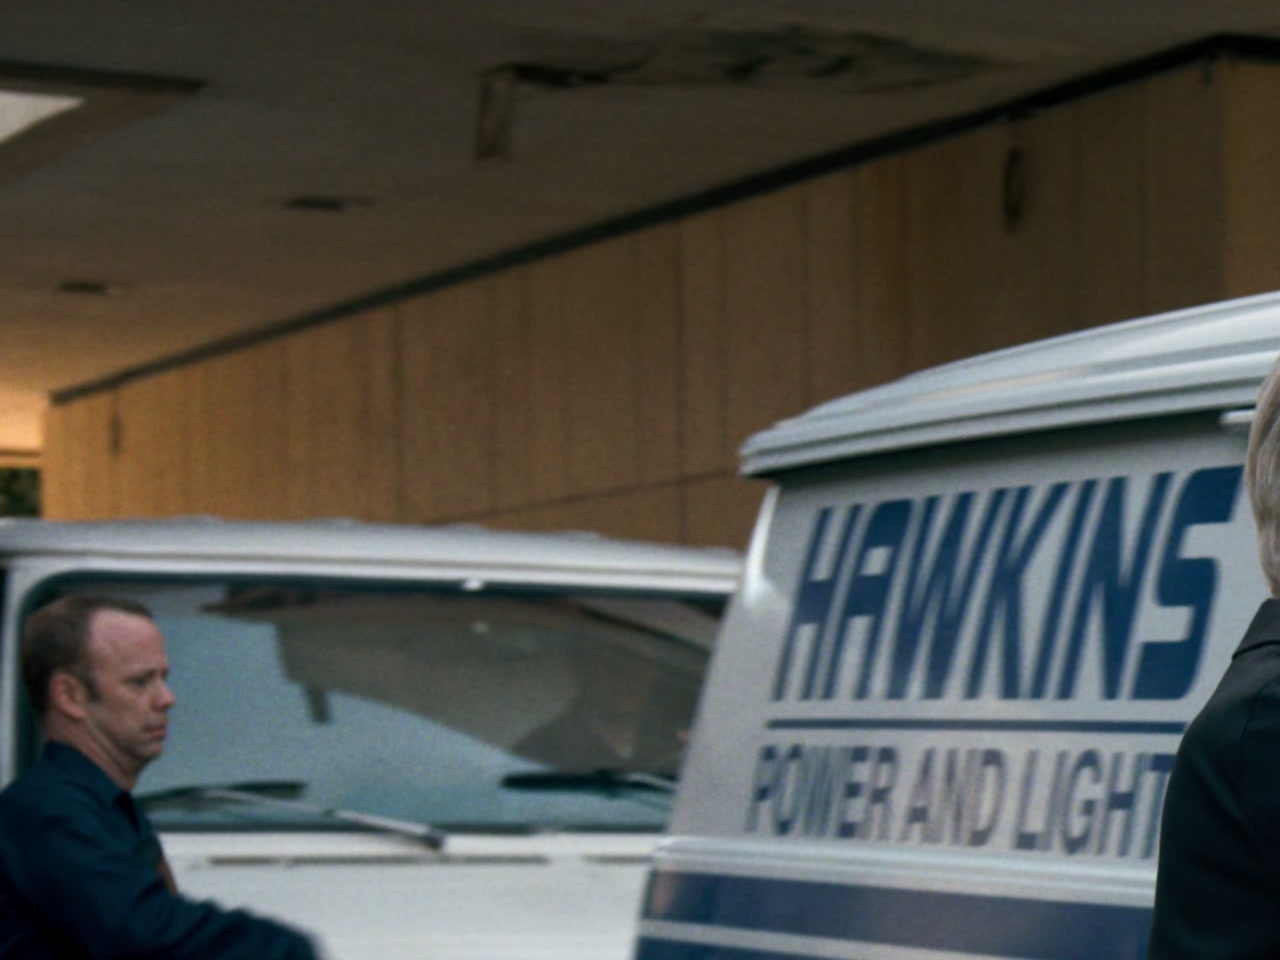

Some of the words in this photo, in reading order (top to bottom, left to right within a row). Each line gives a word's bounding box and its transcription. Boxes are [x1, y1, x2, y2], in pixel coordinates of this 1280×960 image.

[772, 465, 1246, 701] HAWKINS
[746, 744, 898, 842] POWER
[902, 747, 1002, 846] AND
[1014, 750, 1178, 860] LIGHT
